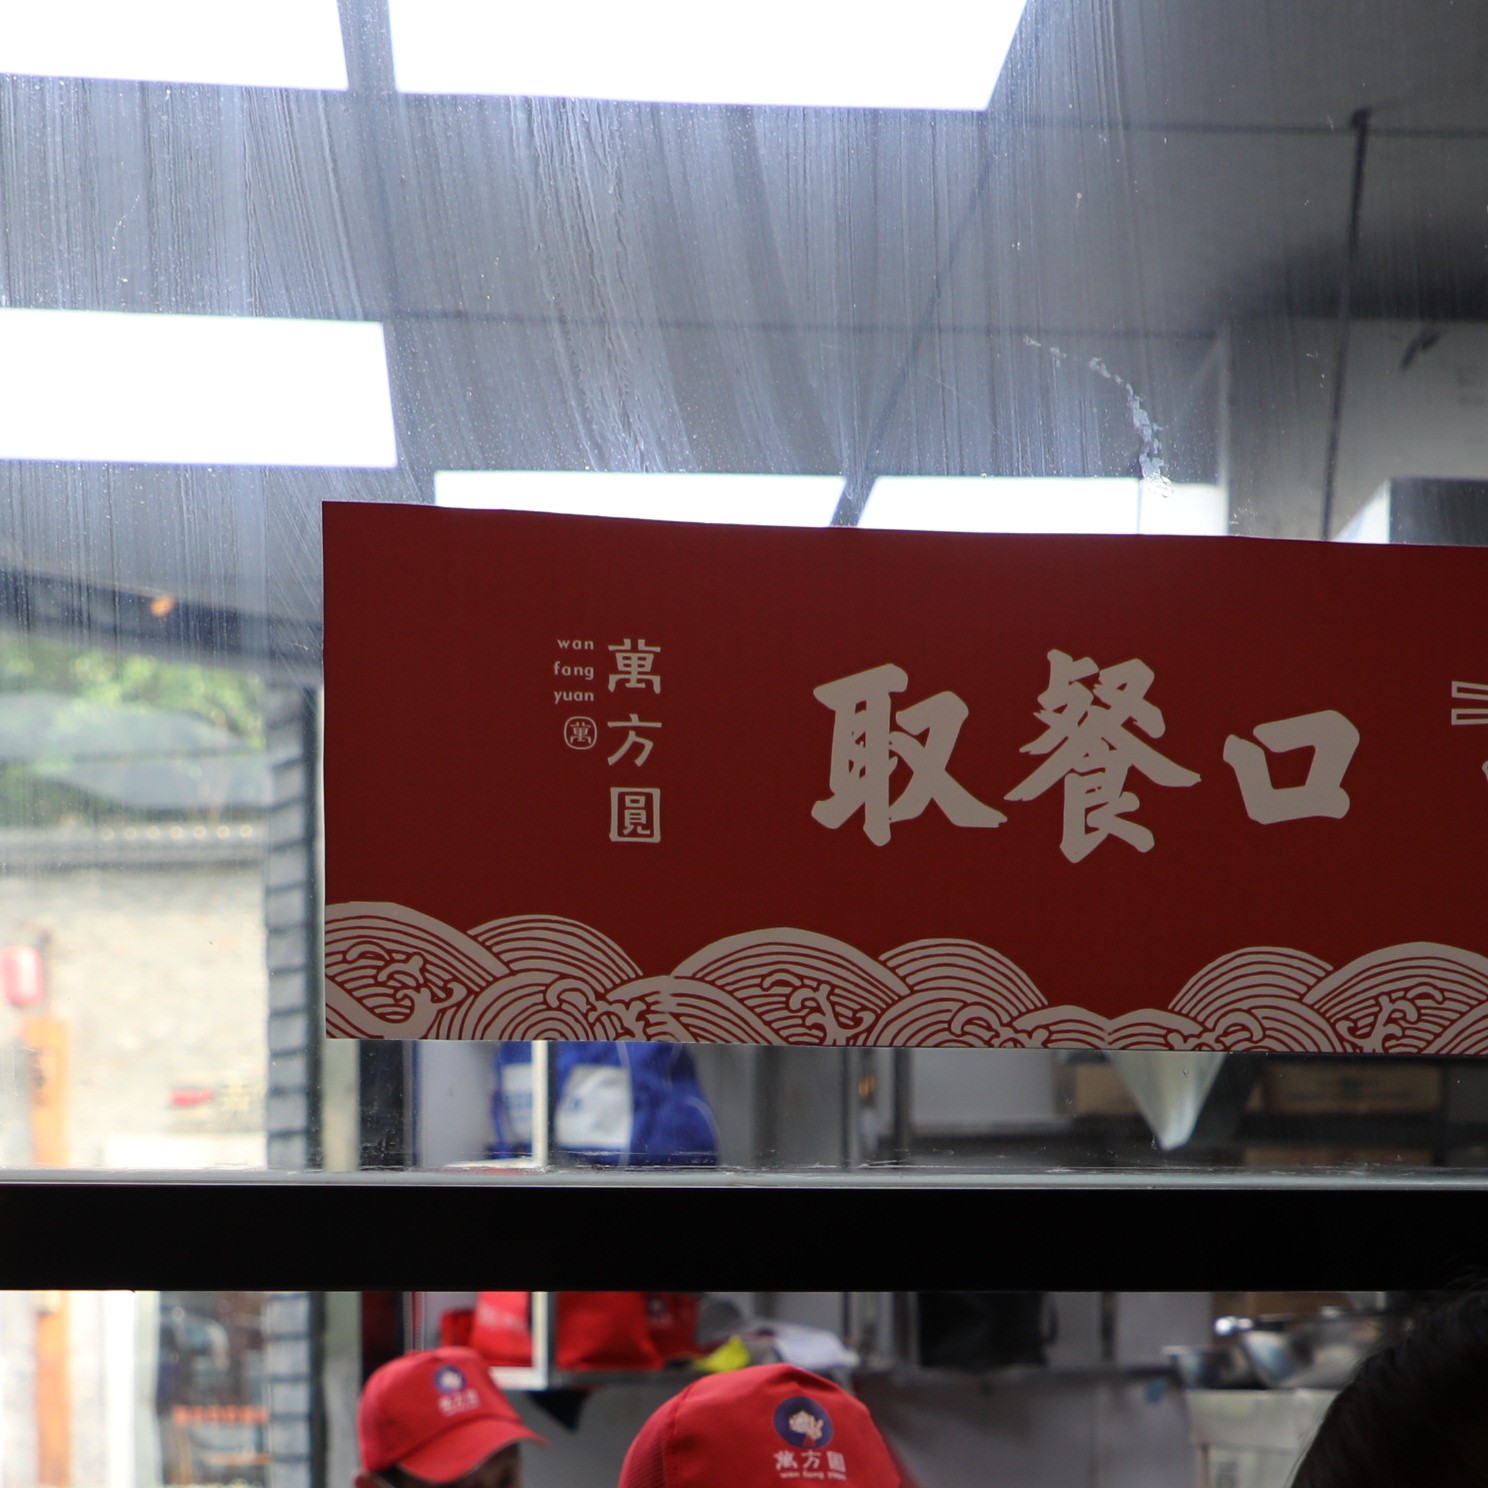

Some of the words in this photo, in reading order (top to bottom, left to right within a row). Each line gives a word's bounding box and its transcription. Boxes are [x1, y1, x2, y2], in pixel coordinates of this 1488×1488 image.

[557, 639, 594, 650] wan
[553, 661, 595, 680] fang
[553, 690, 595, 704] yuan
[607, 638, 662, 843] 萬方圓
[811, 648, 1361, 864] 取餐口
